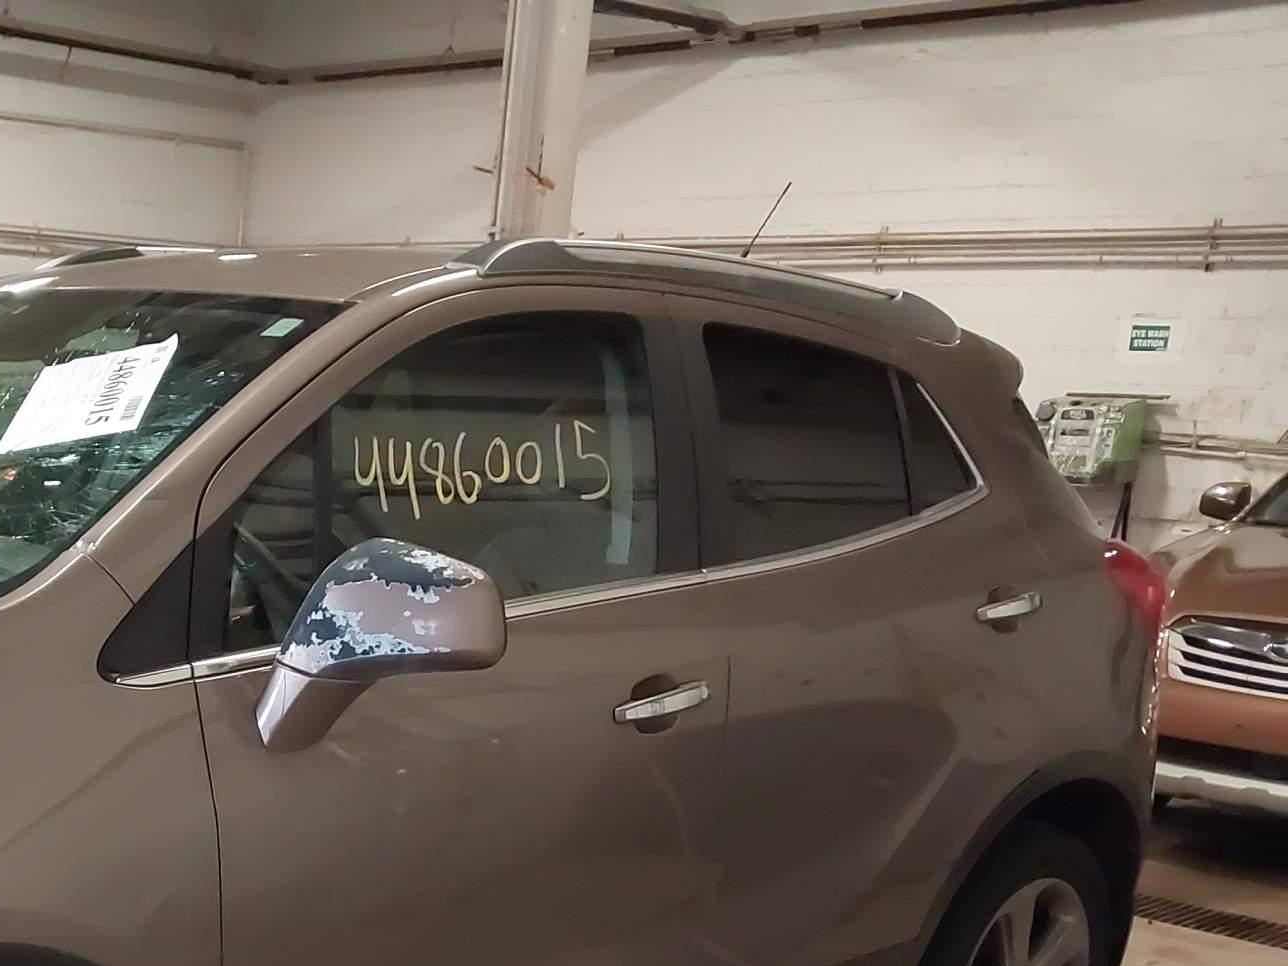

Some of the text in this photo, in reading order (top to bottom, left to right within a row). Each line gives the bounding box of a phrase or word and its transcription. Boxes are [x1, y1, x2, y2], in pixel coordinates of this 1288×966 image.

[1133, 338, 1165, 347] STATION
[84, 356, 141, 426] 44860015
[353, 419, 611, 520] 44860015
